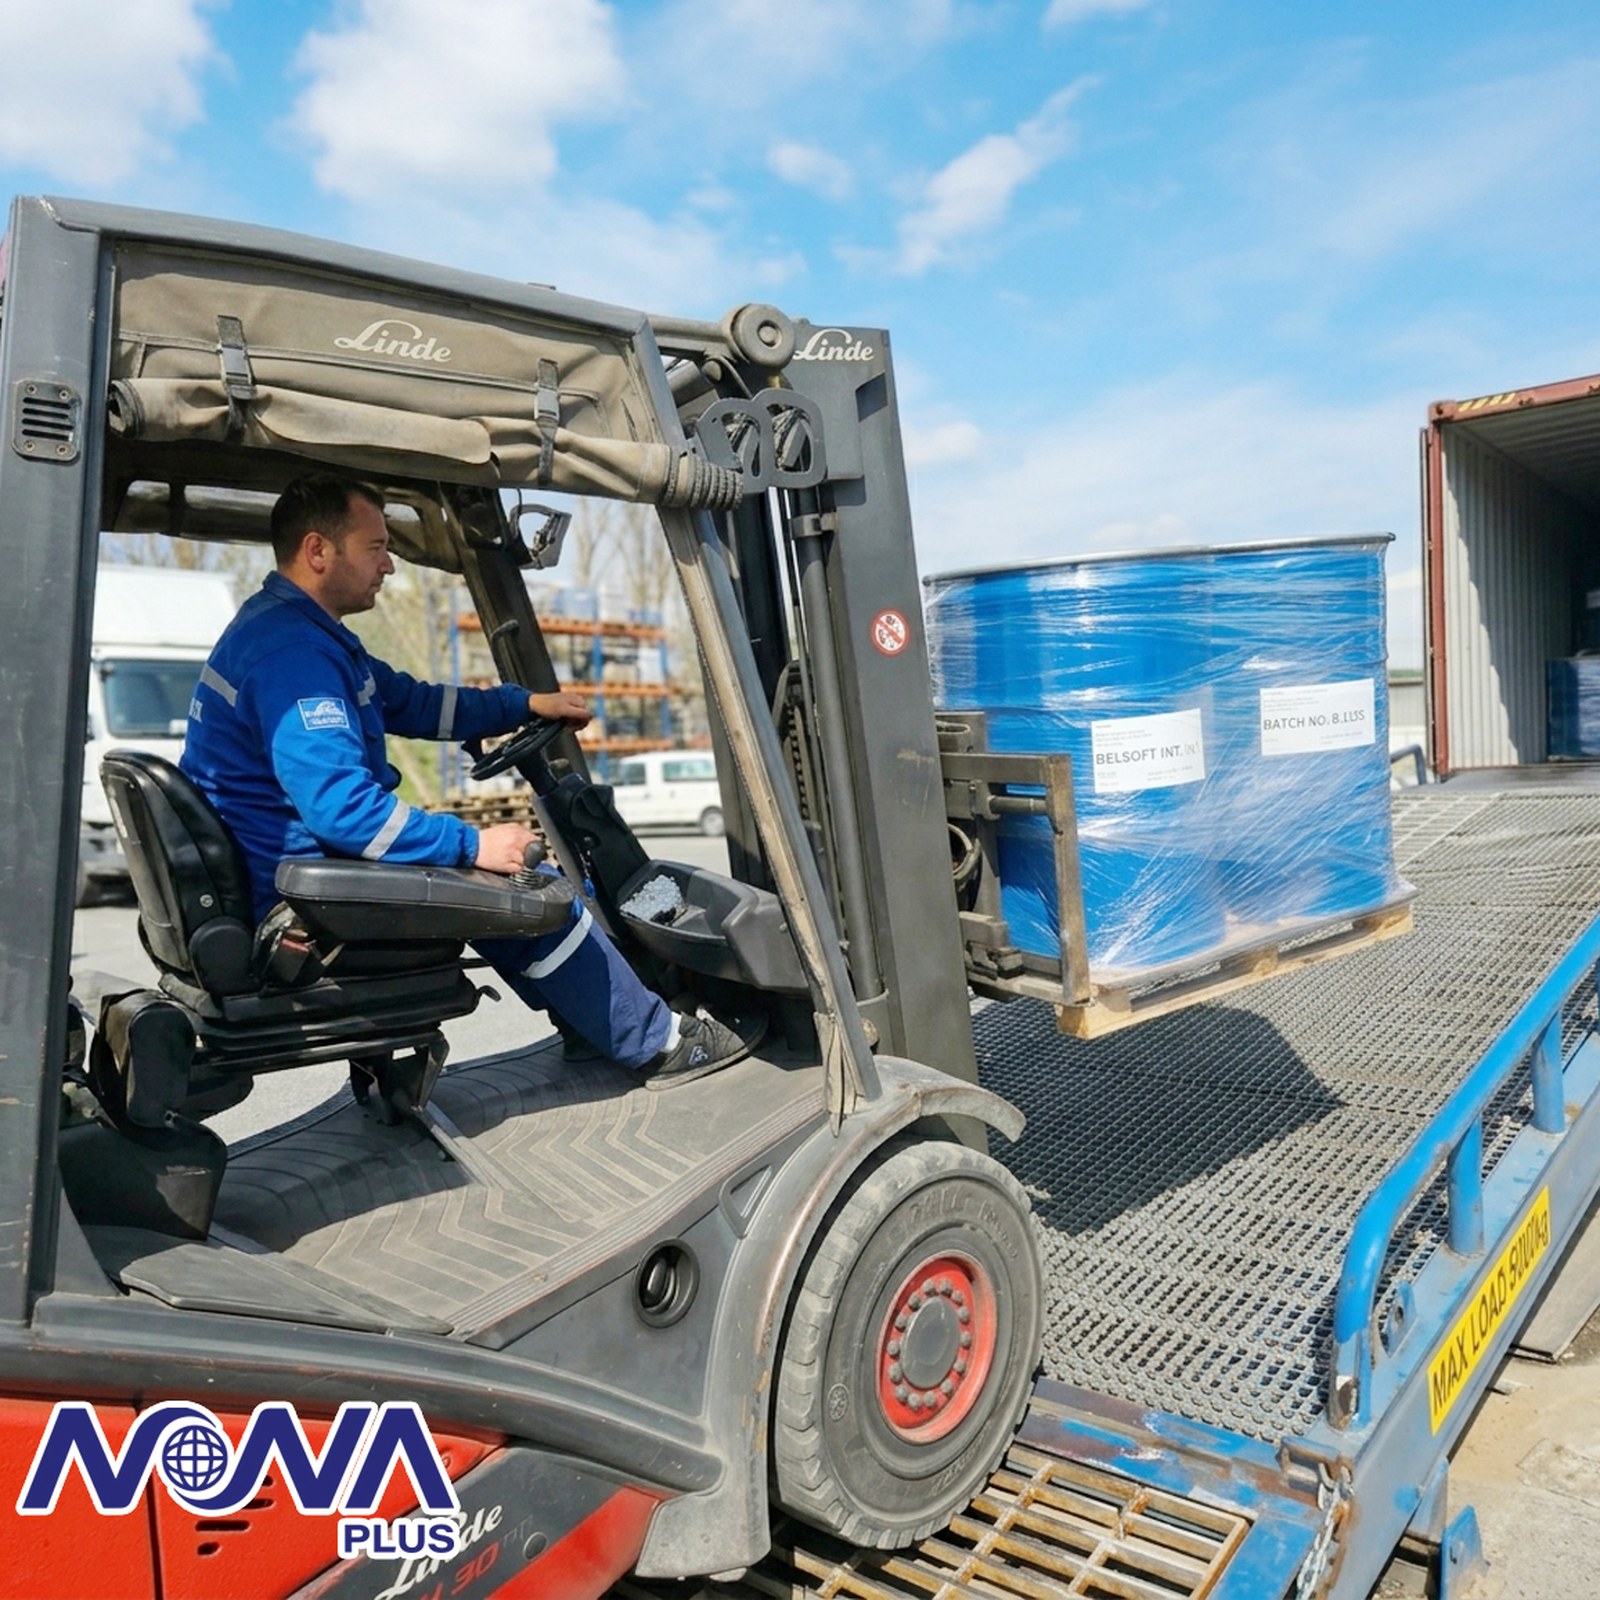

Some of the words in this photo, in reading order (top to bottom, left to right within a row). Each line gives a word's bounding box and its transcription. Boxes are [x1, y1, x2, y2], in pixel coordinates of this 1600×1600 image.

[333, 319, 452, 363] Linde
[793, 328, 874, 361] Linde
[1263, 717, 1305, 730] BATCH
[1308, 715, 1330, 727] NO.
[1096, 748, 1157, 765] BELSOFT
[1433, 1325, 1469, 1416] MAX
[1471, 1269, 1507, 1357] LOAD
